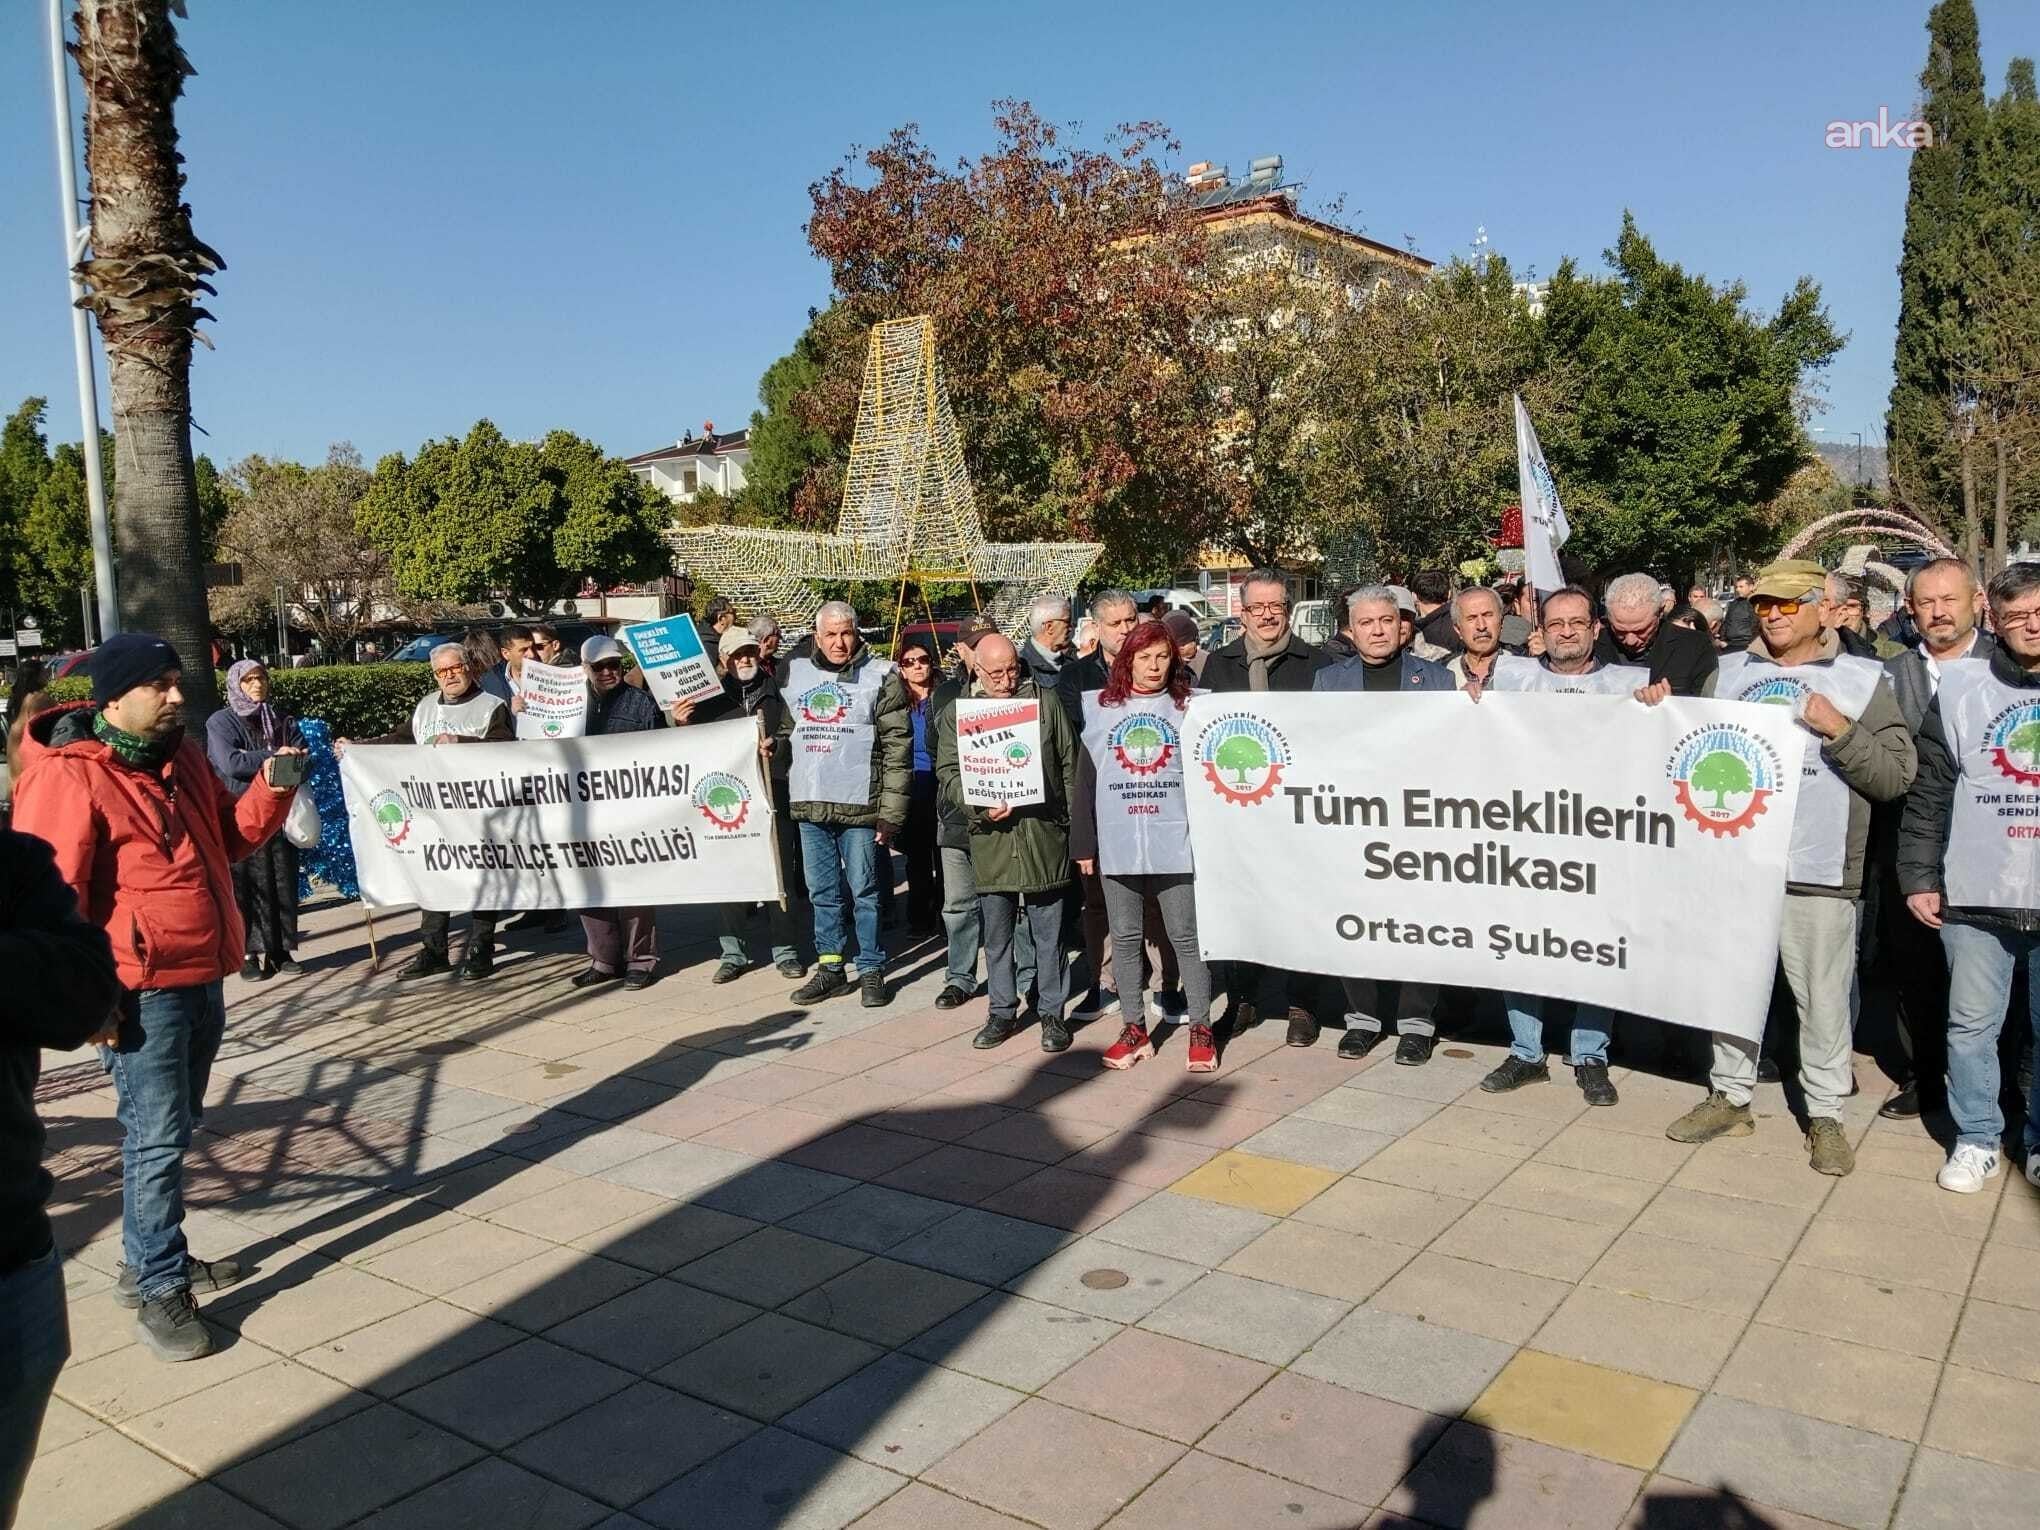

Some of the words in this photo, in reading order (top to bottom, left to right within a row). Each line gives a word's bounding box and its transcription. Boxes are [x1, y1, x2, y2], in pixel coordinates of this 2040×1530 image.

[660, 670, 672, 680] Bu
[674, 662, 702, 677] yağma
[963, 756, 1000, 765] Kader
[964, 764, 1011, 776] Değildir
[400, 775, 436, 810] TÜM
[436, 768, 571, 810] EMEKLİLERİN
[576, 761, 690, 801] SENDİKASI
[1108, 782, 1123, 791] TÜM
[1125, 779, 1180, 789] EMEKLİLERİN
[968, 787, 1038, 800] DEĞİŞTİRELİM
[1121, 791, 1167, 800] SENDİKASI
[1975, 793, 2001, 804] TÜM
[1128, 805, 1159, 815] ORTACA
[1284, 784, 1389, 828] Tüm
[1403, 788, 1676, 848] Emeklilerin
[1709, 810, 1730, 819] 2017
[423, 837, 514, 871] KÖYCEĞİZ
[510, 838, 558, 876] İLÇE
[557, 826, 698, 869] TEMSİLCİLİĞİ
[1363, 840, 1597, 895] Sendikası
[1335, 913, 1474, 949] Ortaca
[1488, 923, 1627, 970] Şubesi
